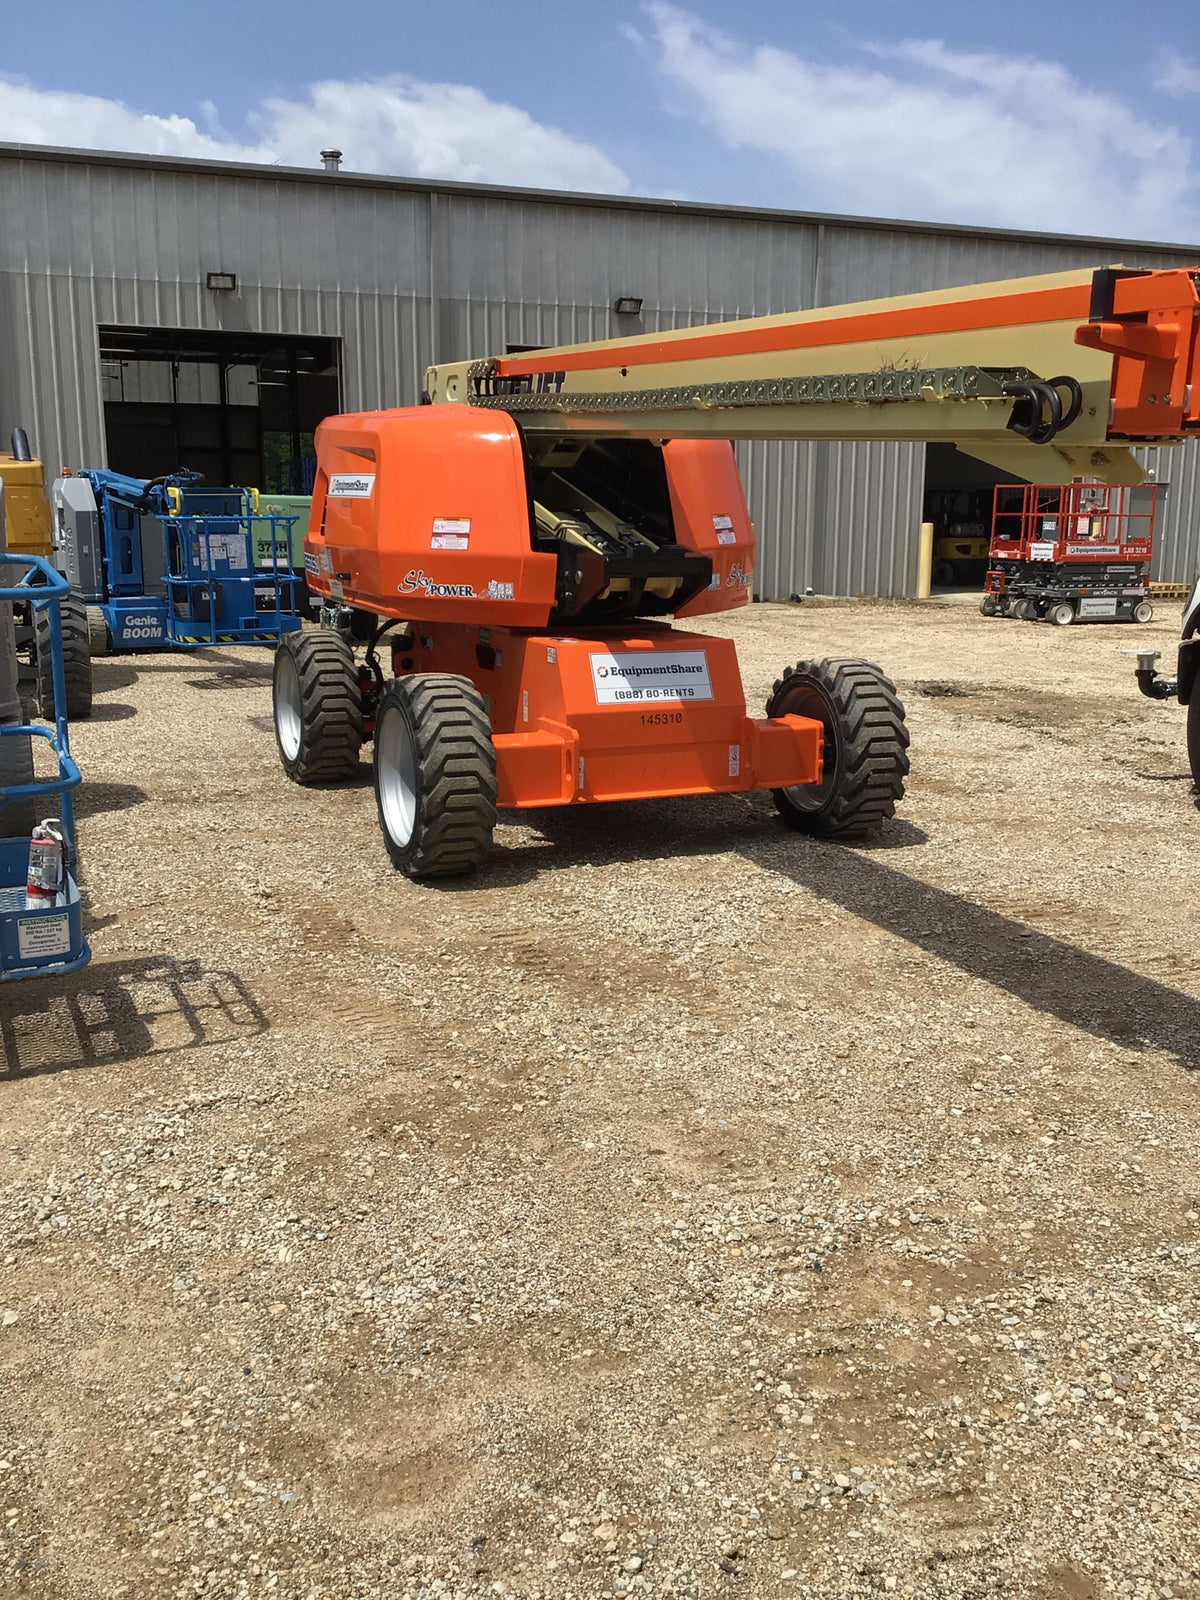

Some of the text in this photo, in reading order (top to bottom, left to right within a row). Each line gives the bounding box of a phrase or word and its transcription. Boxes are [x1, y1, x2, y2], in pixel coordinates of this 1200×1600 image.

[257, 542, 288, 552] 37H
[430, 584, 474, 597] POWER
[125, 615, 160, 626] Genie
[122, 627, 162, 639] BOOM
[610, 664, 703, 677] EquipmentShare
[614, 688, 695, 700] (888) 80-RENTS
[640, 712, 683, 725] 145310
